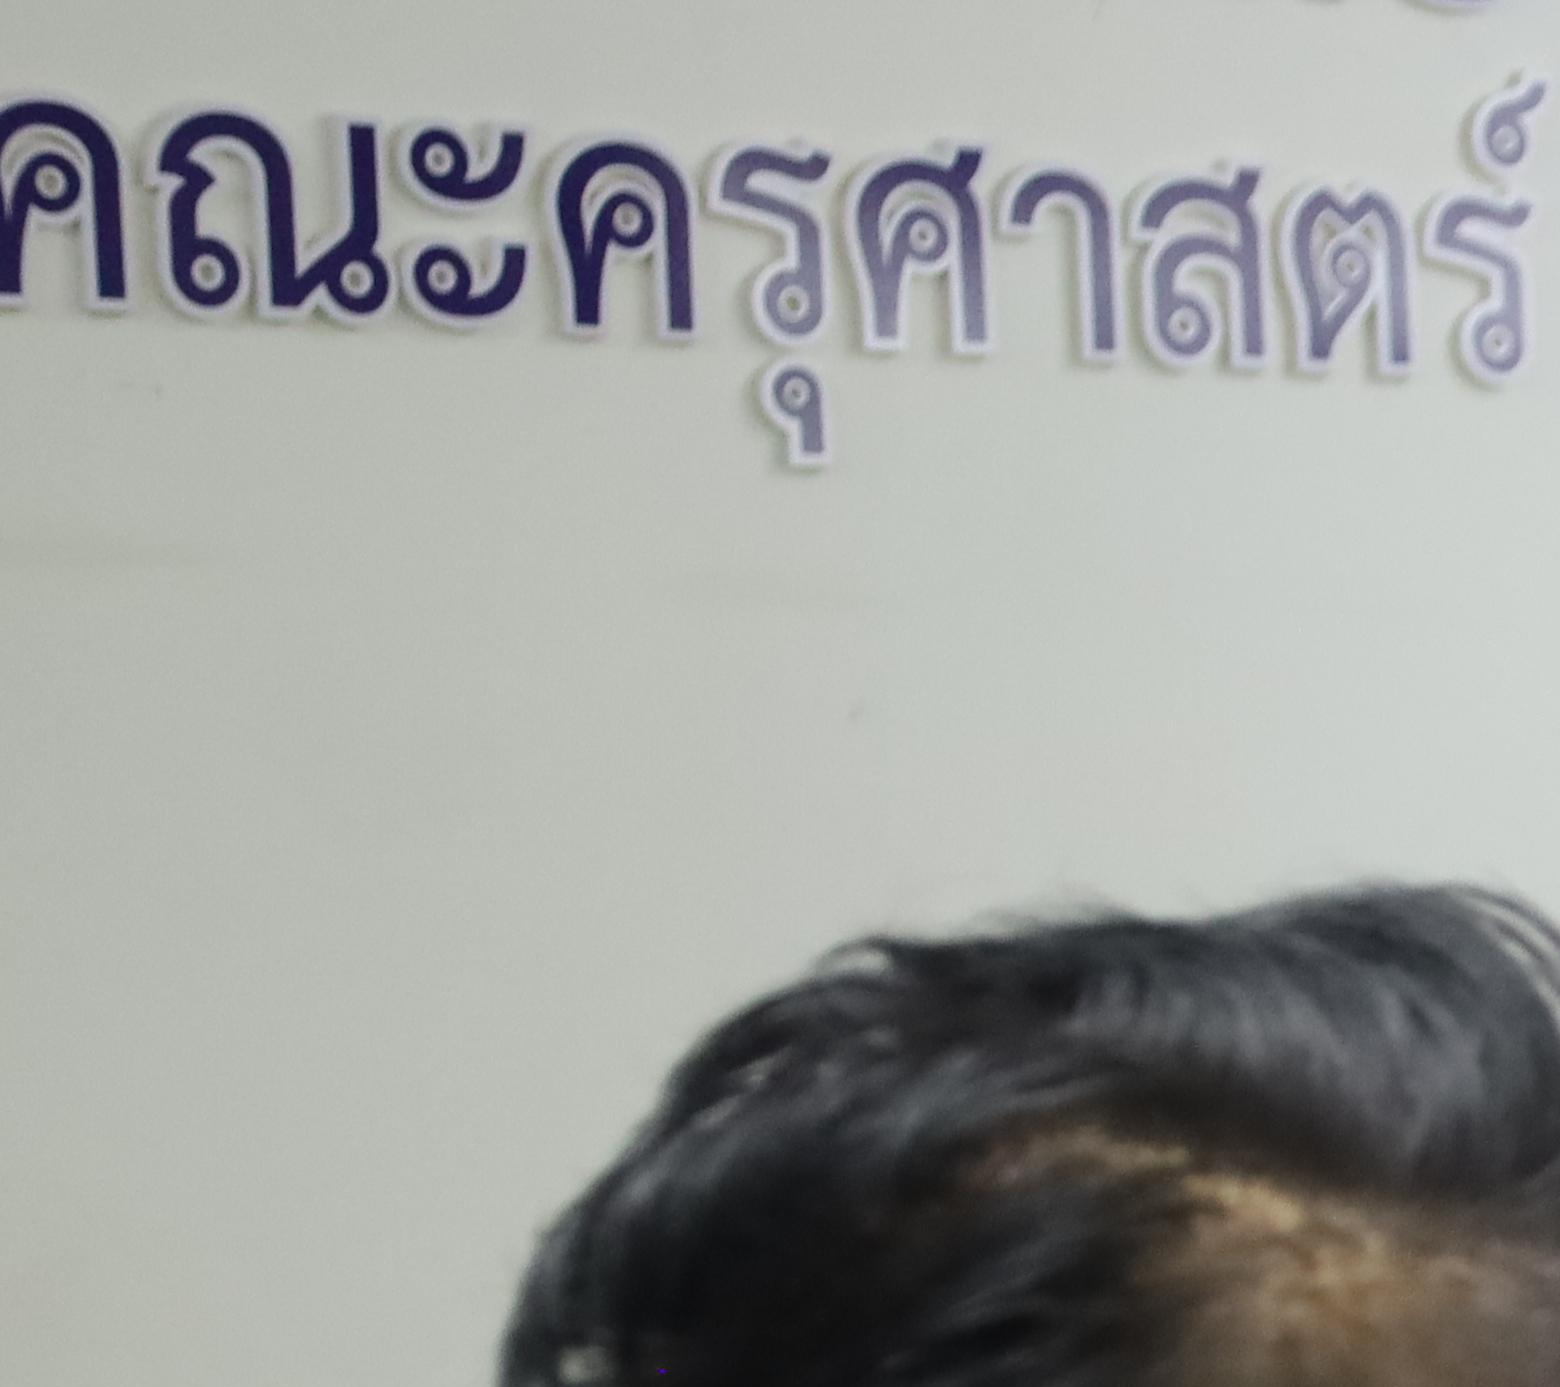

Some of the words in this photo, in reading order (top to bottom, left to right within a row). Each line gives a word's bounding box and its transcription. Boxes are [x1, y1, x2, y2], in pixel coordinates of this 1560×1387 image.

[0, 80, 1548, 465] คณะครุศาสตร์
